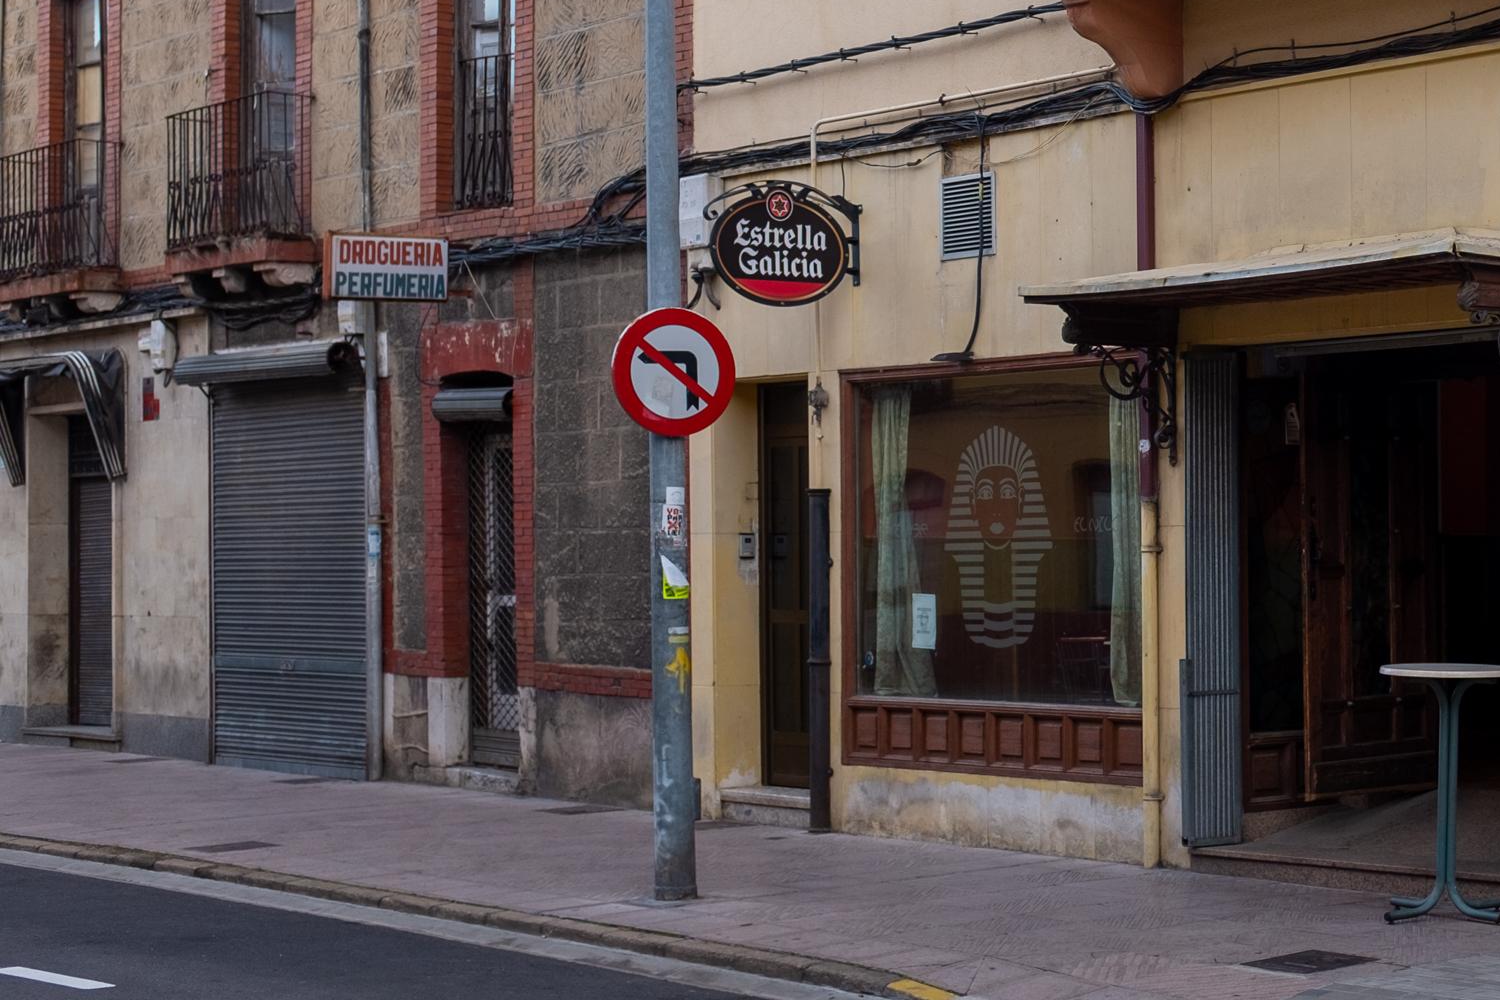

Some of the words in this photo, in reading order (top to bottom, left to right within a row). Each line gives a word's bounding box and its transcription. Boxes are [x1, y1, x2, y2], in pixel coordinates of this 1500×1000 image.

[733, 217, 827, 251] Estrella
[339, 238, 443, 267] DROGUERIA
[738, 246, 824, 279] Galicia
[334, 271, 446, 298] PERFUMERIA
